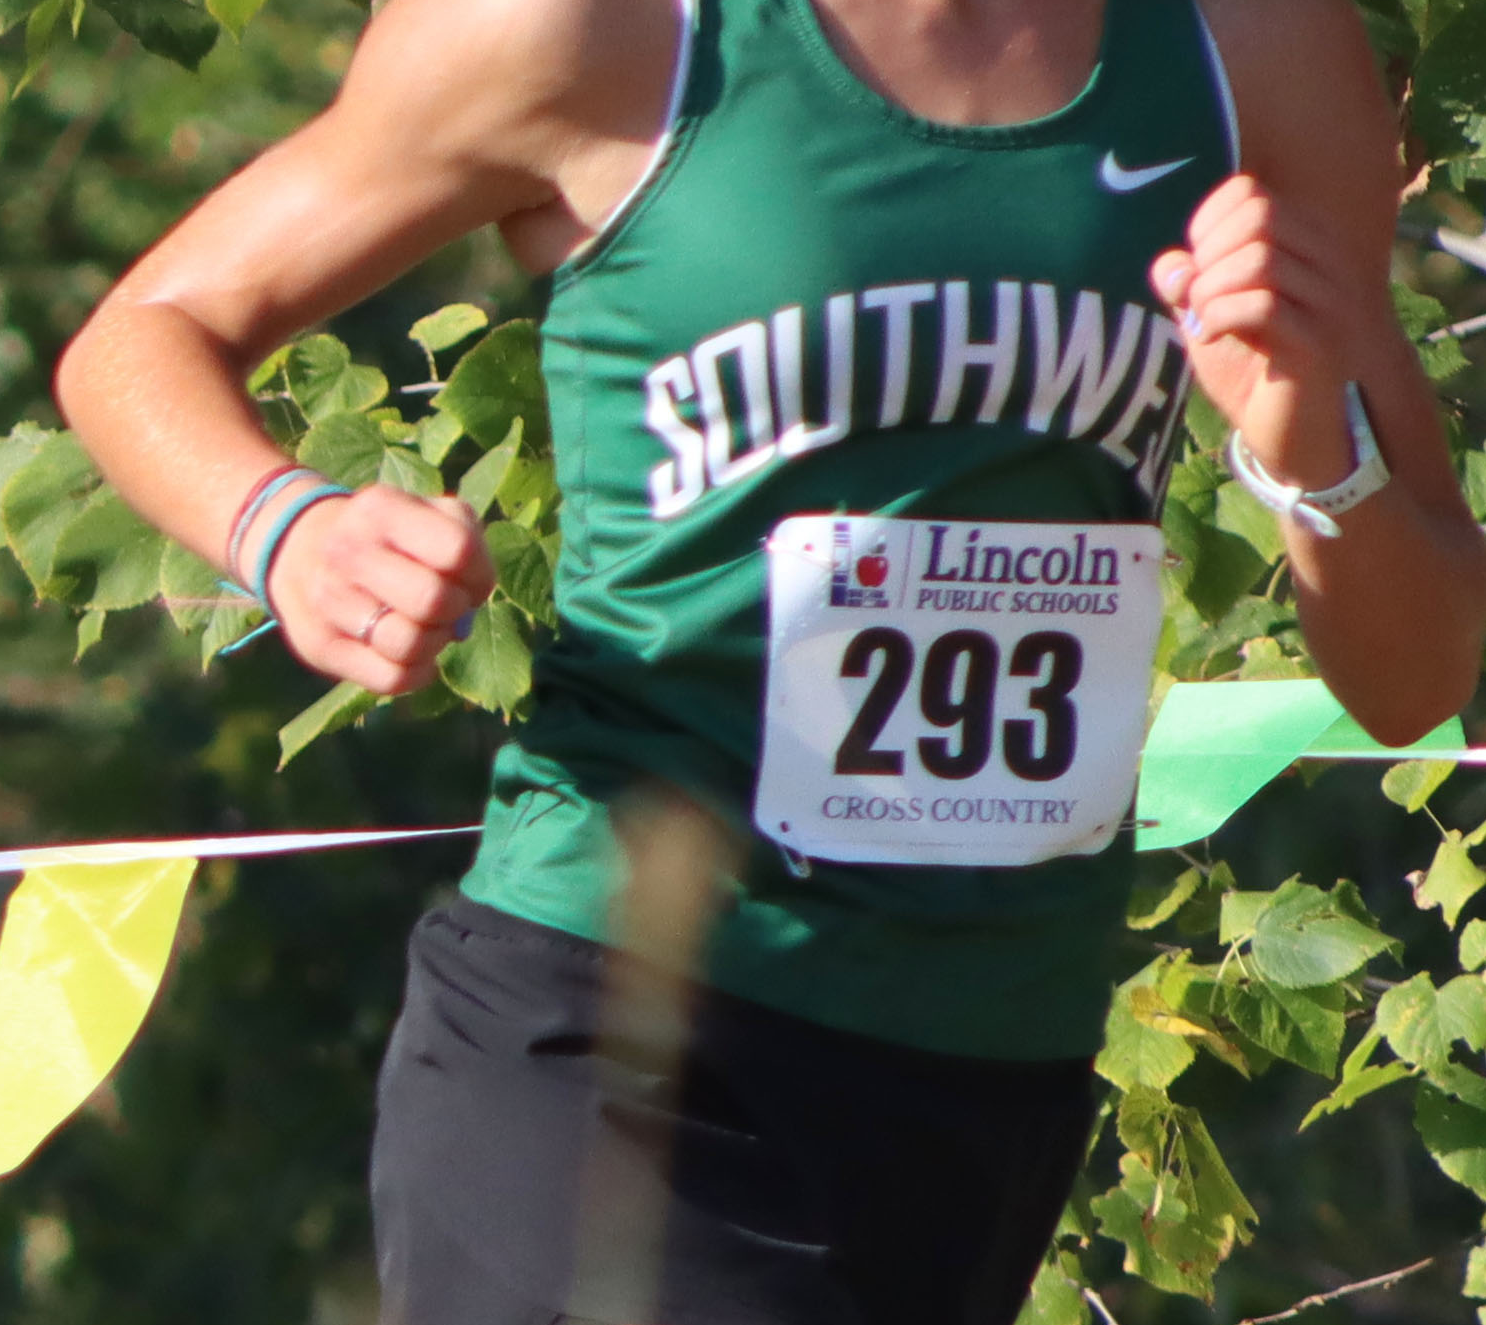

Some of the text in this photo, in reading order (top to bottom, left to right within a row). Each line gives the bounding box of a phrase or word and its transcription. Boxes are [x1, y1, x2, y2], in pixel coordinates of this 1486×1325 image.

[645, 280, 1191, 519] SOUTHWE
[921, 525, 1121, 586] Lincoln
[915, 588, 1119, 615] PUBLIC SCHOOLS
[833, 626, 1084, 782] 293
[822, 794, 1079, 824] CROSS COUNTRY
